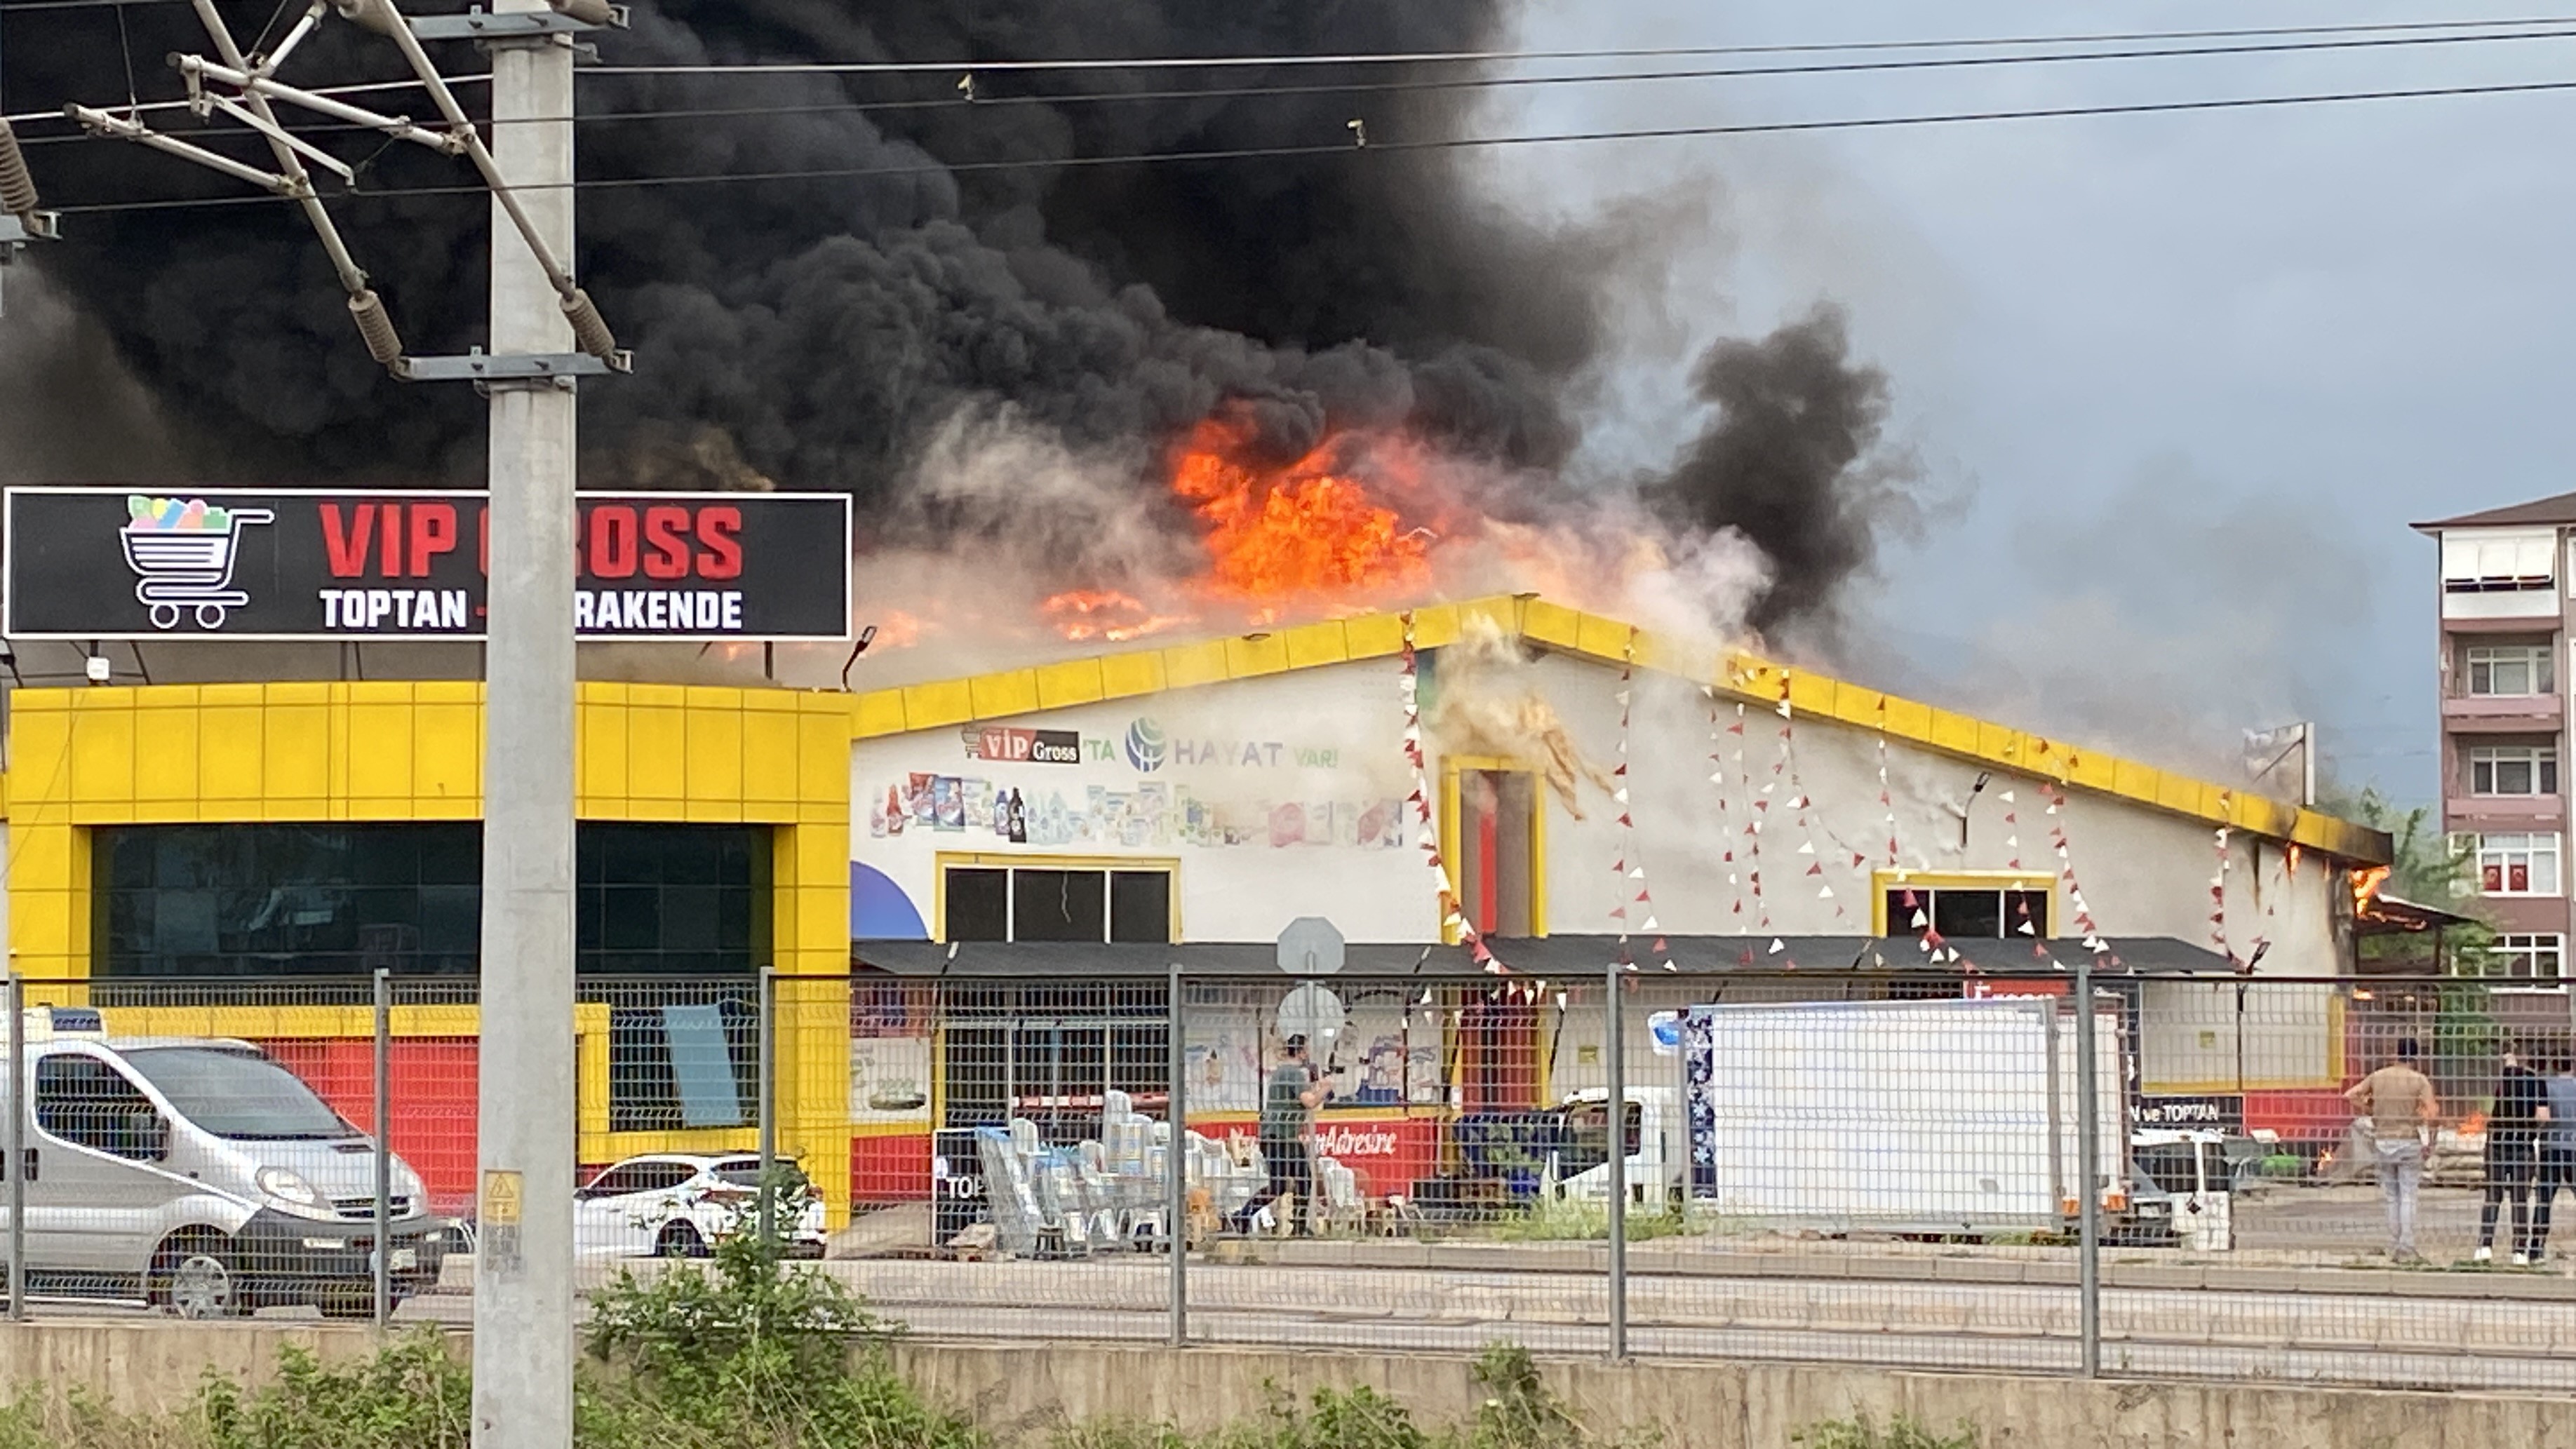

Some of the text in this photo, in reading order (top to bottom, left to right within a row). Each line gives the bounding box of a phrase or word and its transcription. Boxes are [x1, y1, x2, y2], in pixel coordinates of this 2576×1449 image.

[319, 503, 742, 579] VIP OSS
[319, 590, 467, 628] TOPTAN
[1174, 739, 1284, 767] HAYAT
